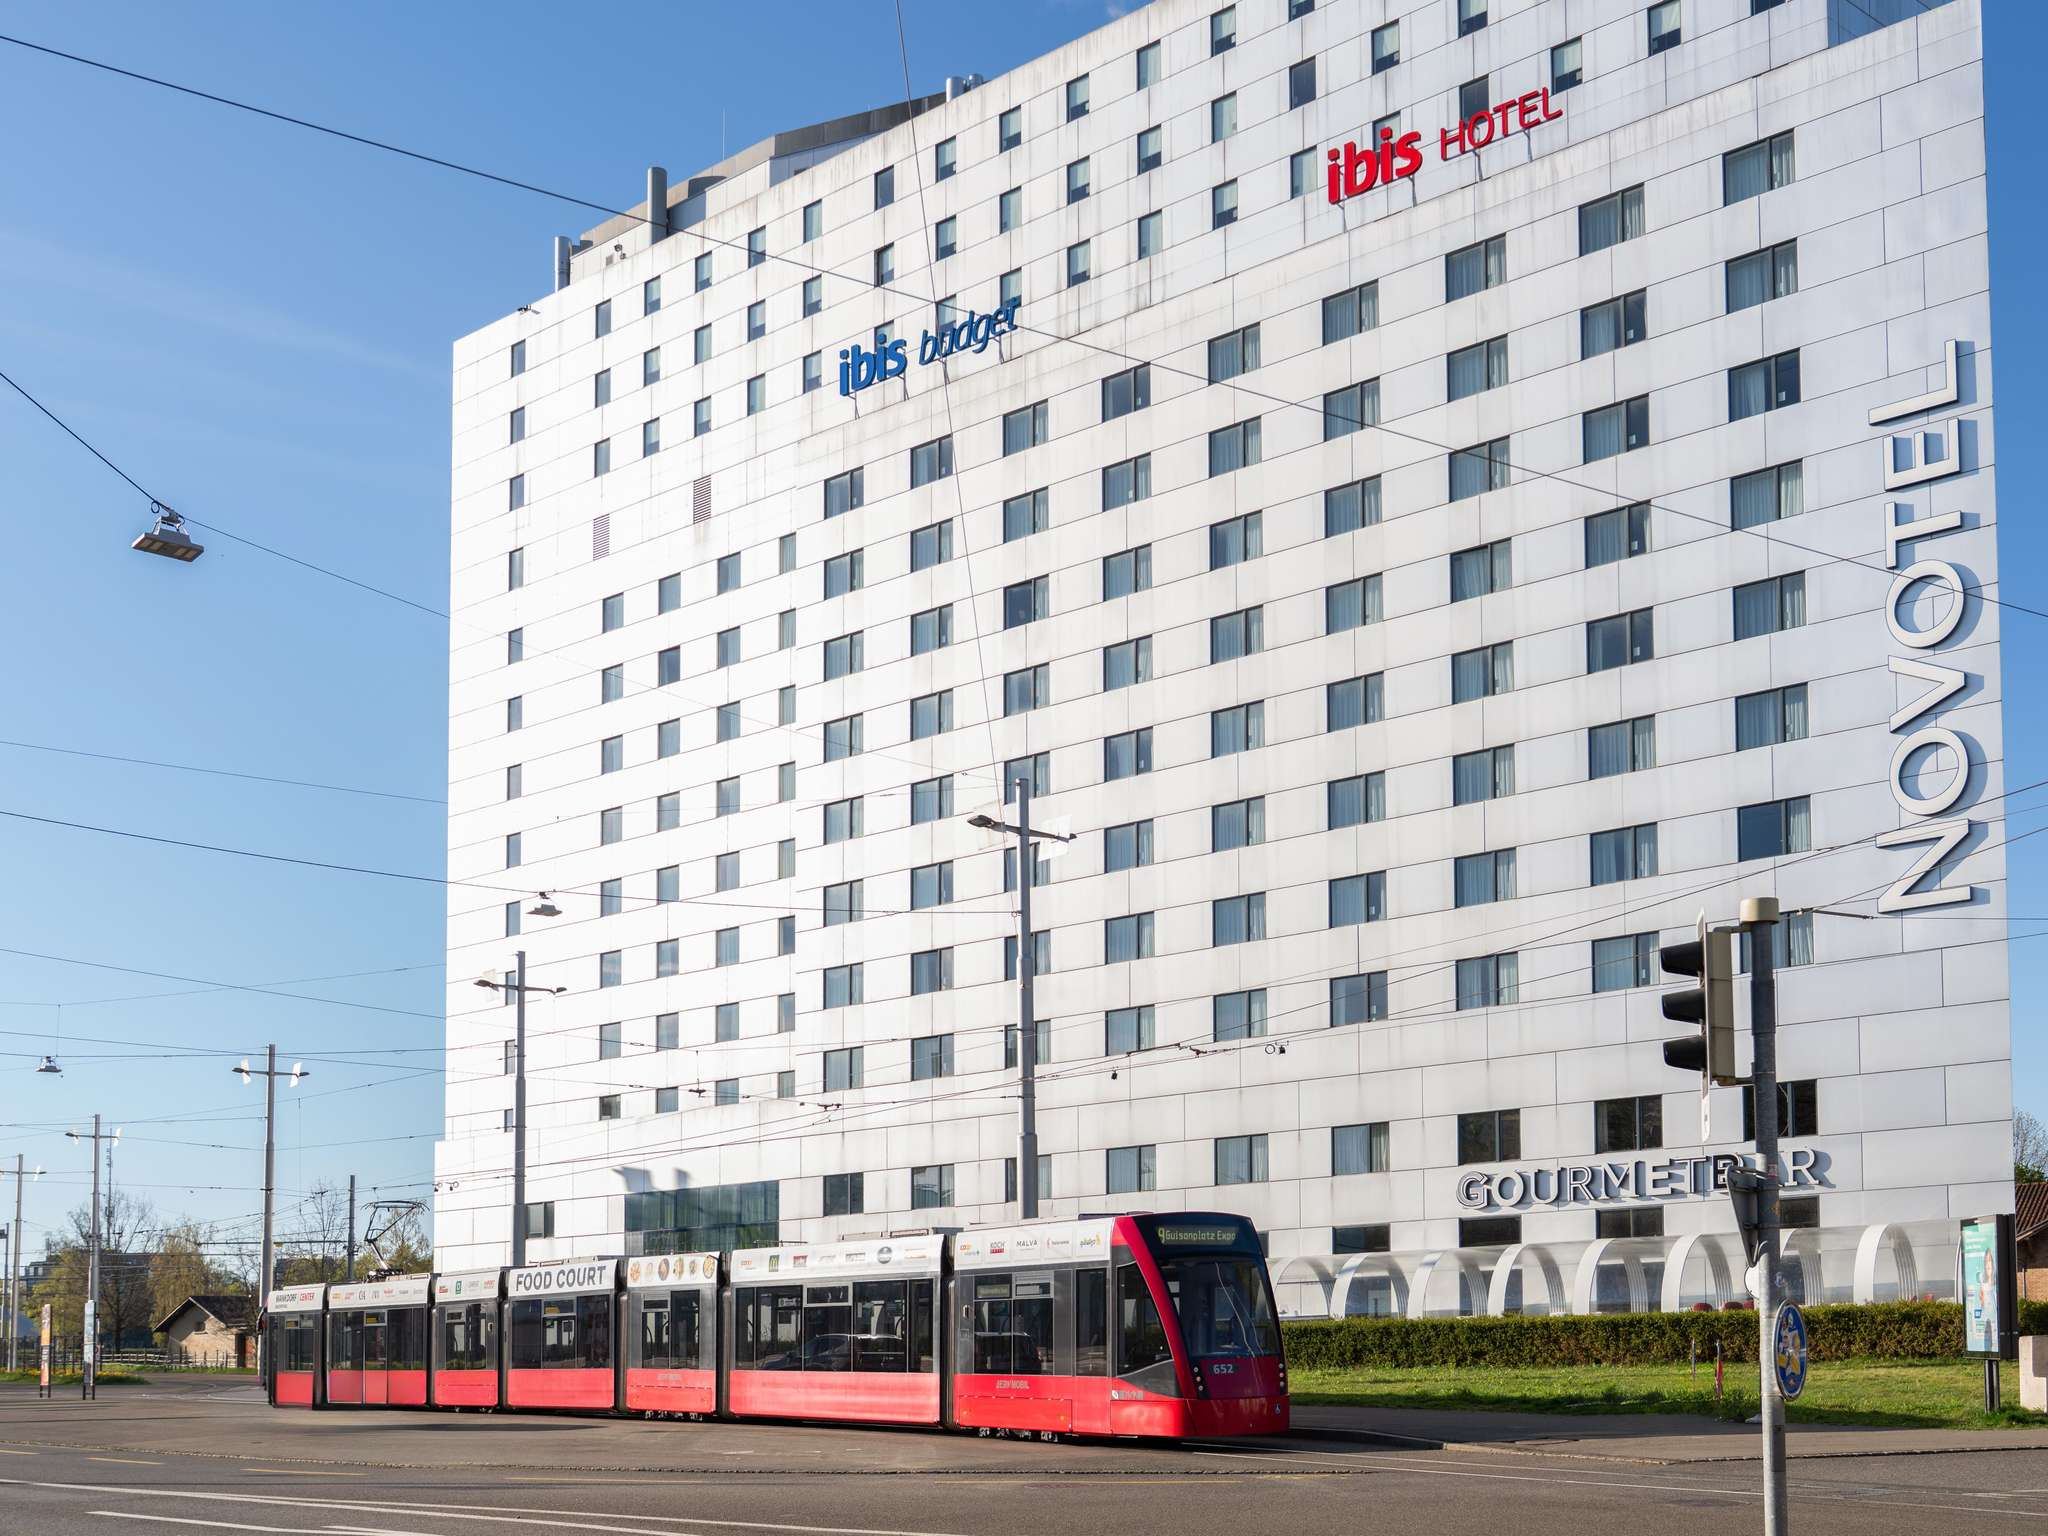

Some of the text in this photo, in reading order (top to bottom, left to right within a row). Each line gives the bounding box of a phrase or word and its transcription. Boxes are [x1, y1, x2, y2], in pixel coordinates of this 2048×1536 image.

[1328, 87, 1563, 204] ibis HOTEL
[840, 297, 1018, 396] ibis budget
[1868, 338, 1973, 913] NOVOTEL
[1016, 1239, 1038, 1248] MALVA
[1158, 1227, 1165, 1244] 9
[515, 1271, 551, 1292] FOOD
[556, 1266, 606, 1288] COURT
[1213, 1364, 1234, 1375] 652
